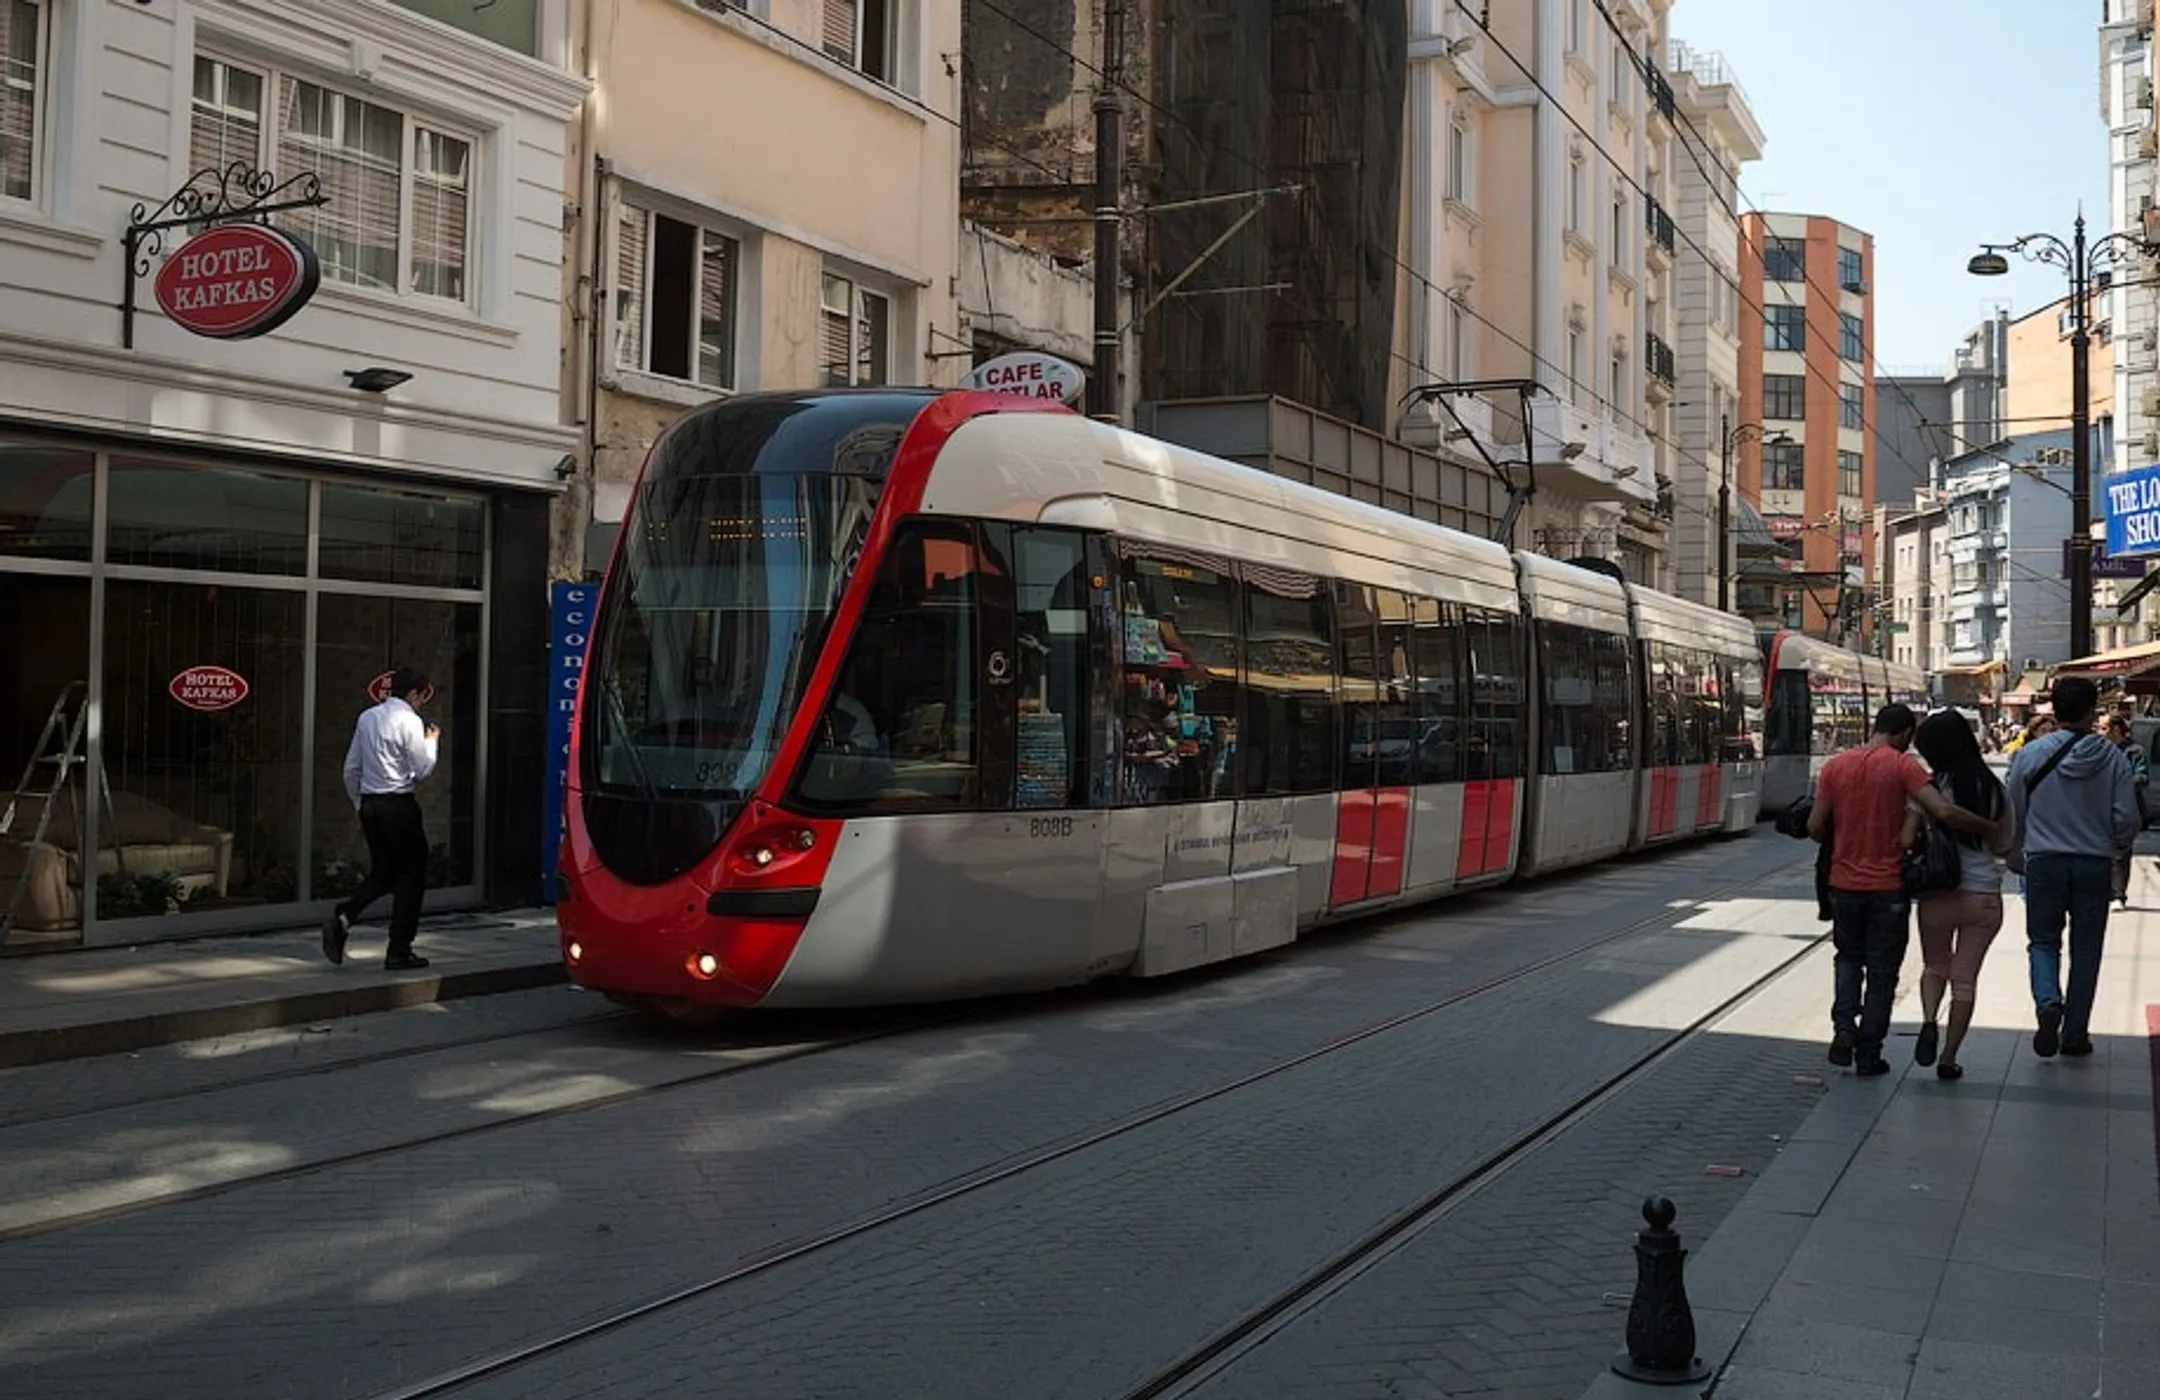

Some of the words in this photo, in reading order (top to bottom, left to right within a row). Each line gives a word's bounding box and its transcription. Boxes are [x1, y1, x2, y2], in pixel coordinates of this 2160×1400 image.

[181, 244, 270, 279] HOTEL
[174, 277, 275, 310] KAFKAS
[986, 362, 1043, 385] CAFE
[2108, 482, 2139, 515] THE
[2140, 477, 2160, 509] LO
[2127, 511, 2160, 545] SHO
[182, 687, 237, 699] KAFKAS
[185, 673, 234, 686] HOTEL
[1030, 816, 1073, 838] 808B
